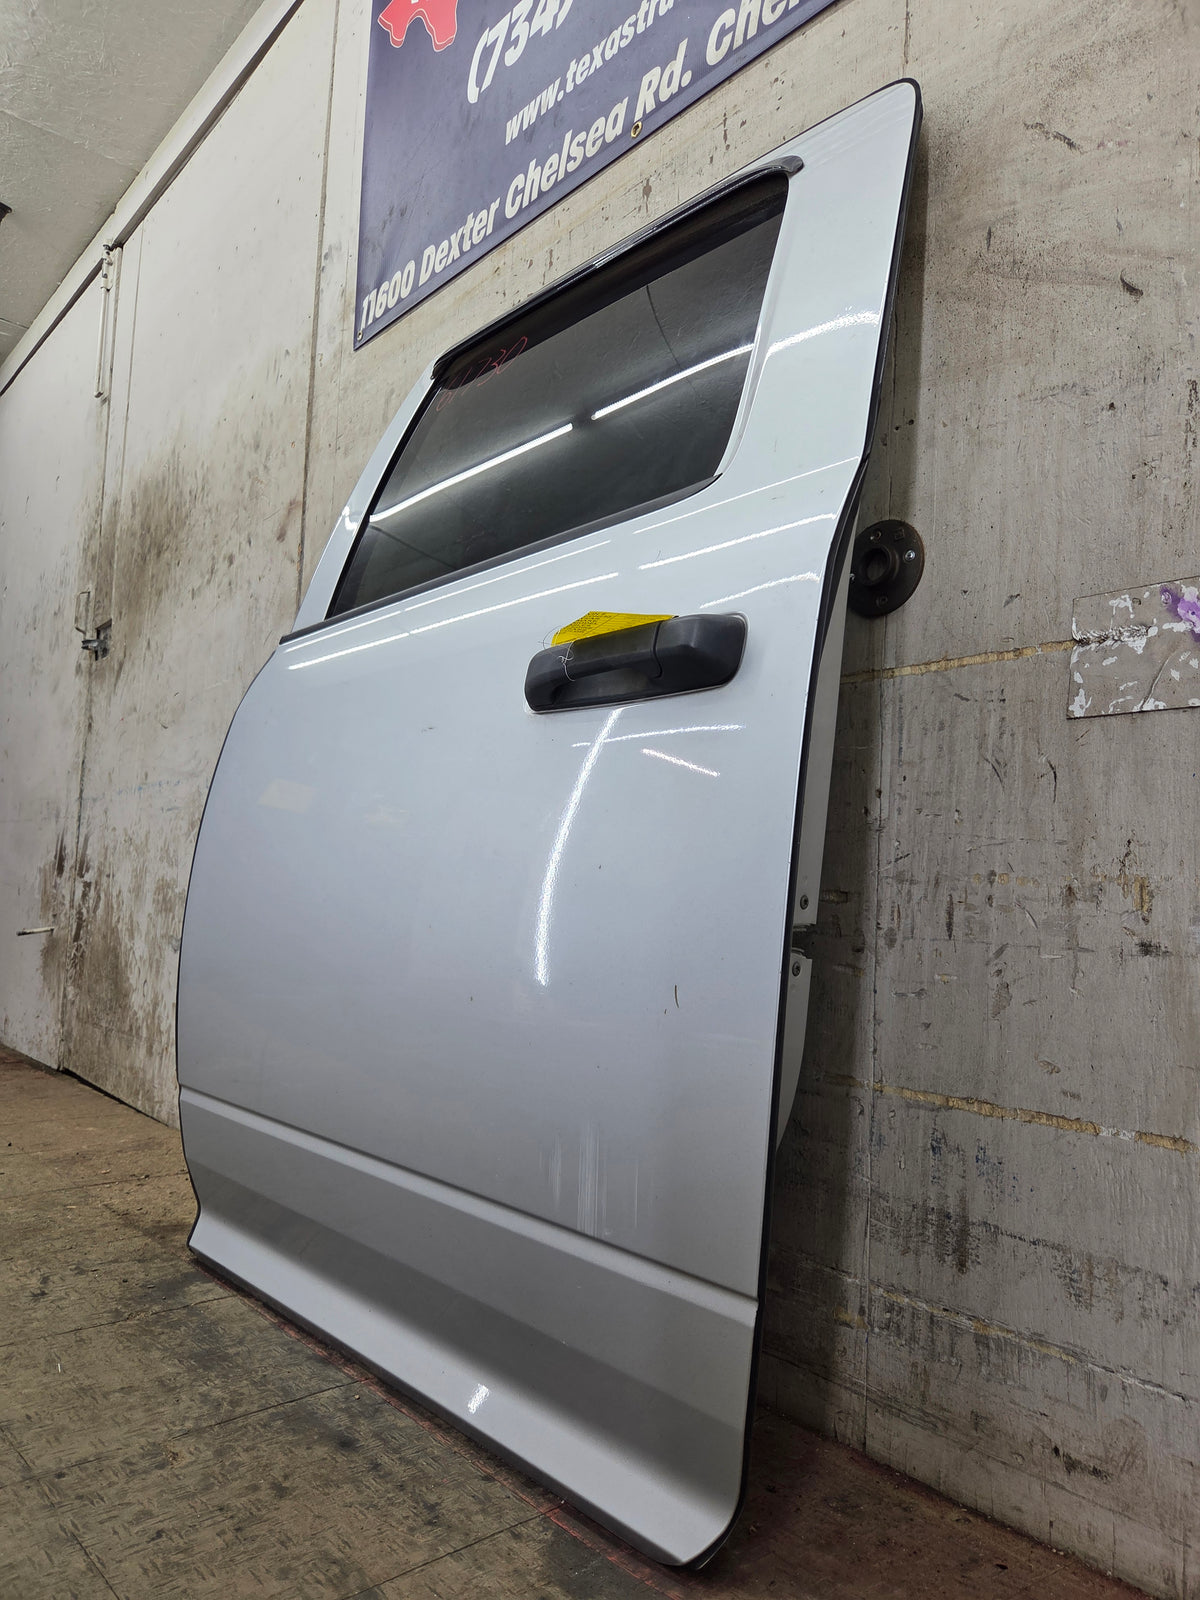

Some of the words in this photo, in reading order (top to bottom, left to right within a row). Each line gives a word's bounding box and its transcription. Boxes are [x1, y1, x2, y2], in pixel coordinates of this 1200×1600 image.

[361, 259, 416, 329] 11600
[418, 196, 501, 287] Dexter
[504, 96, 629, 219] Chelsea
[633, 37, 692, 123] Rd.
[705, 0, 800, 66] Che
